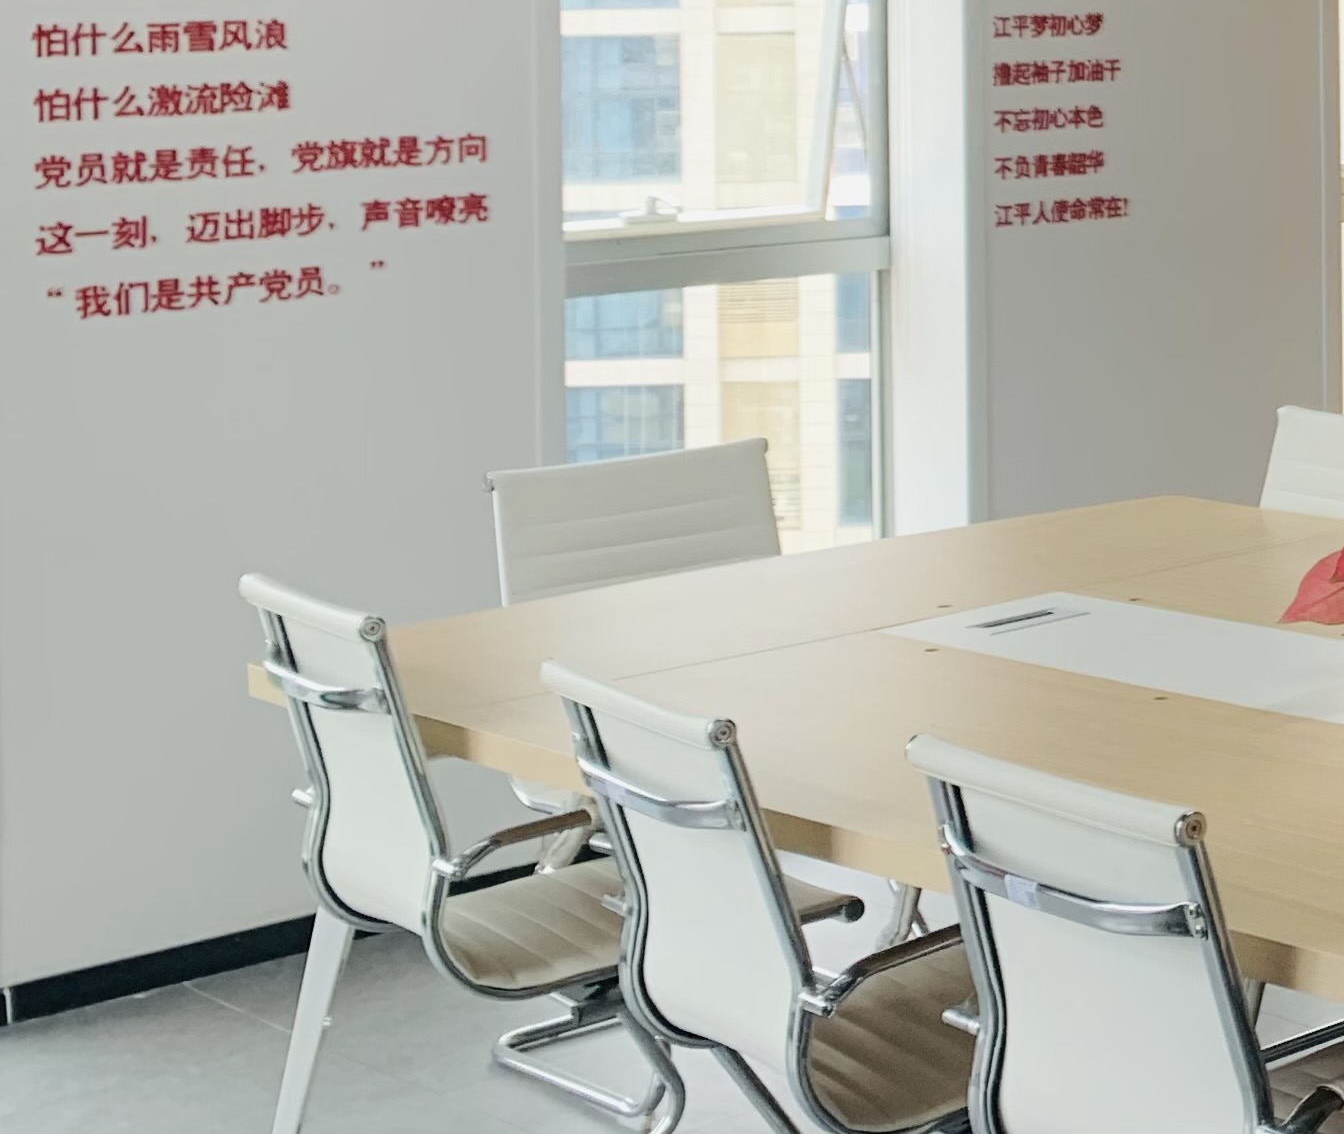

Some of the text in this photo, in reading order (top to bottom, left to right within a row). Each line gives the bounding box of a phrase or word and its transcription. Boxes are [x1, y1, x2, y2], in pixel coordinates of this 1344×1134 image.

[33, 19, 287, 56] 怕什么雨雪风浪
[993, 13, 1104, 37] 江平梦初心梦
[994, 60, 1119, 86] 撸起袖子加油干
[34, 82, 290, 121] 怕什么激流险滩
[993, 107, 1103, 131] 不忘初心本色
[34, 134, 488, 188] 党员就是责任，党旗就是方向
[993, 151, 1104, 177] 不负青春韶华
[37, 194, 488, 255] 这一刻，迈出脚步，声音嘹亮
